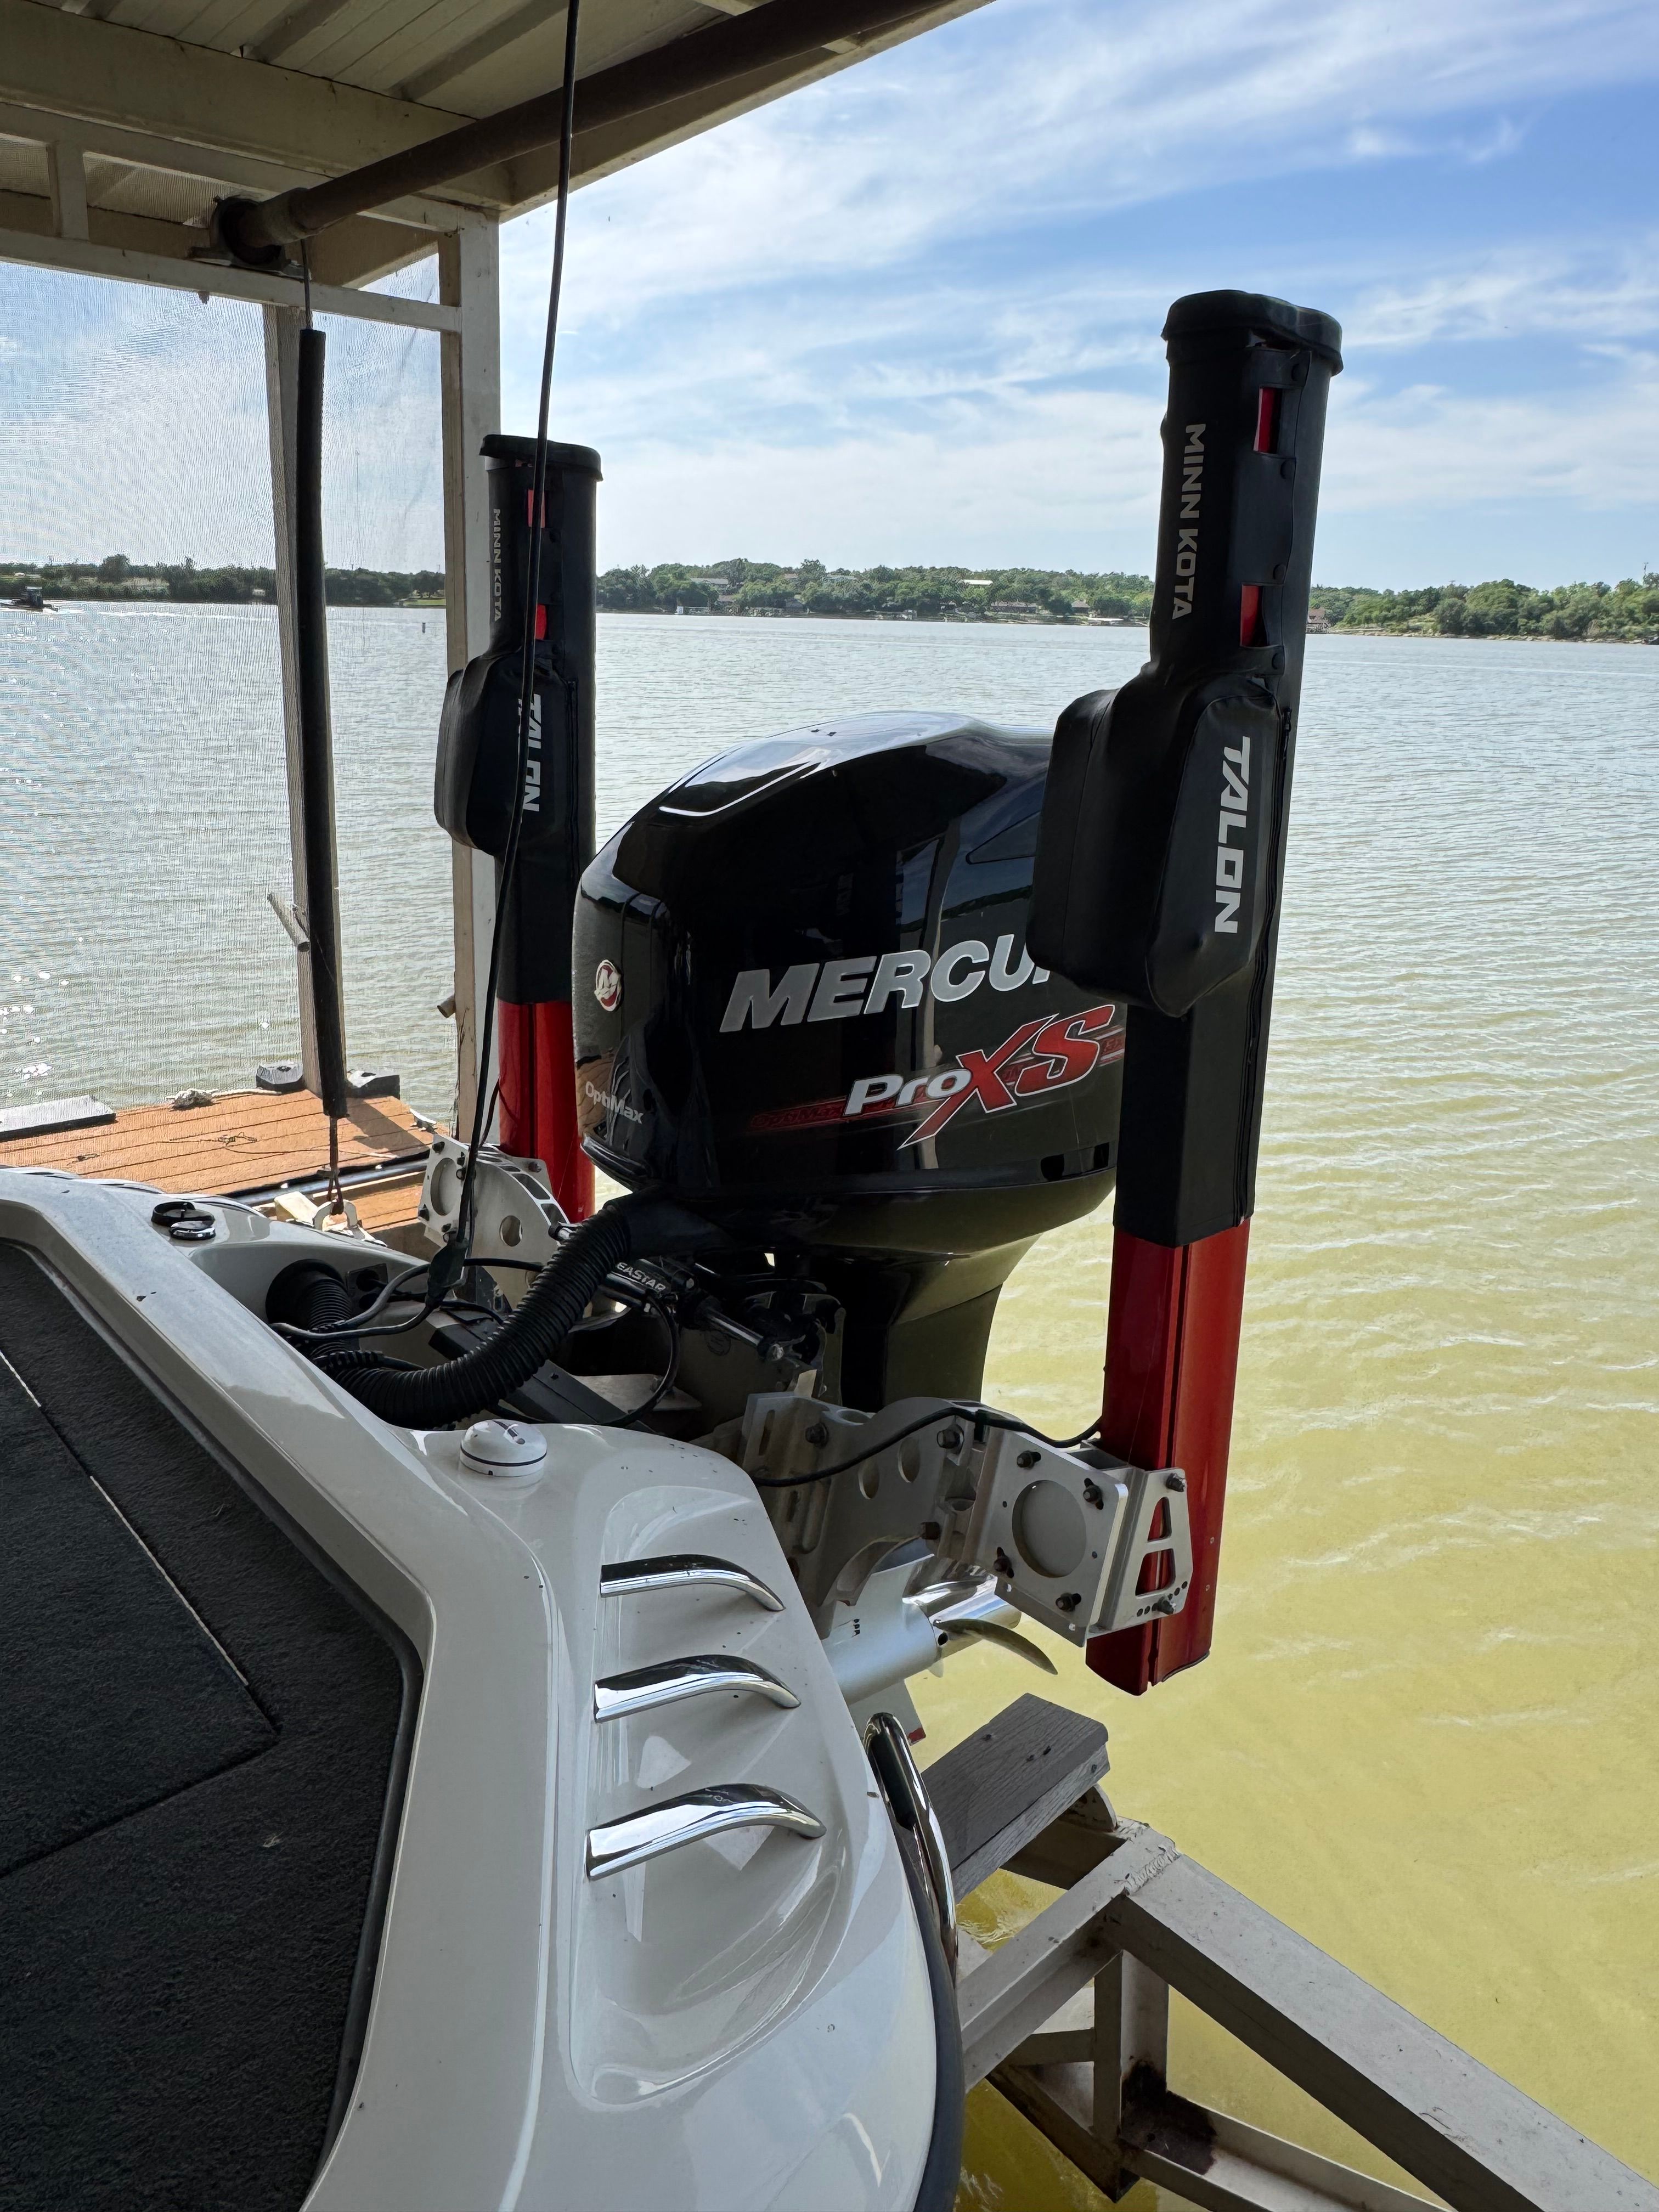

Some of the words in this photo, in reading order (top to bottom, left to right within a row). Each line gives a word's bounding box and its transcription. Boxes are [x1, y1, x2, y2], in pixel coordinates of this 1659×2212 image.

[1180, 424, 1207, 519] MINN
[493, 509, 502, 564] MINN
[1172, 529, 1199, 620] KOTA
[494, 568, 503, 622] KOTA
[1214, 736, 1250, 934] TALON
[719, 934, 1051, 1032] MERCU
